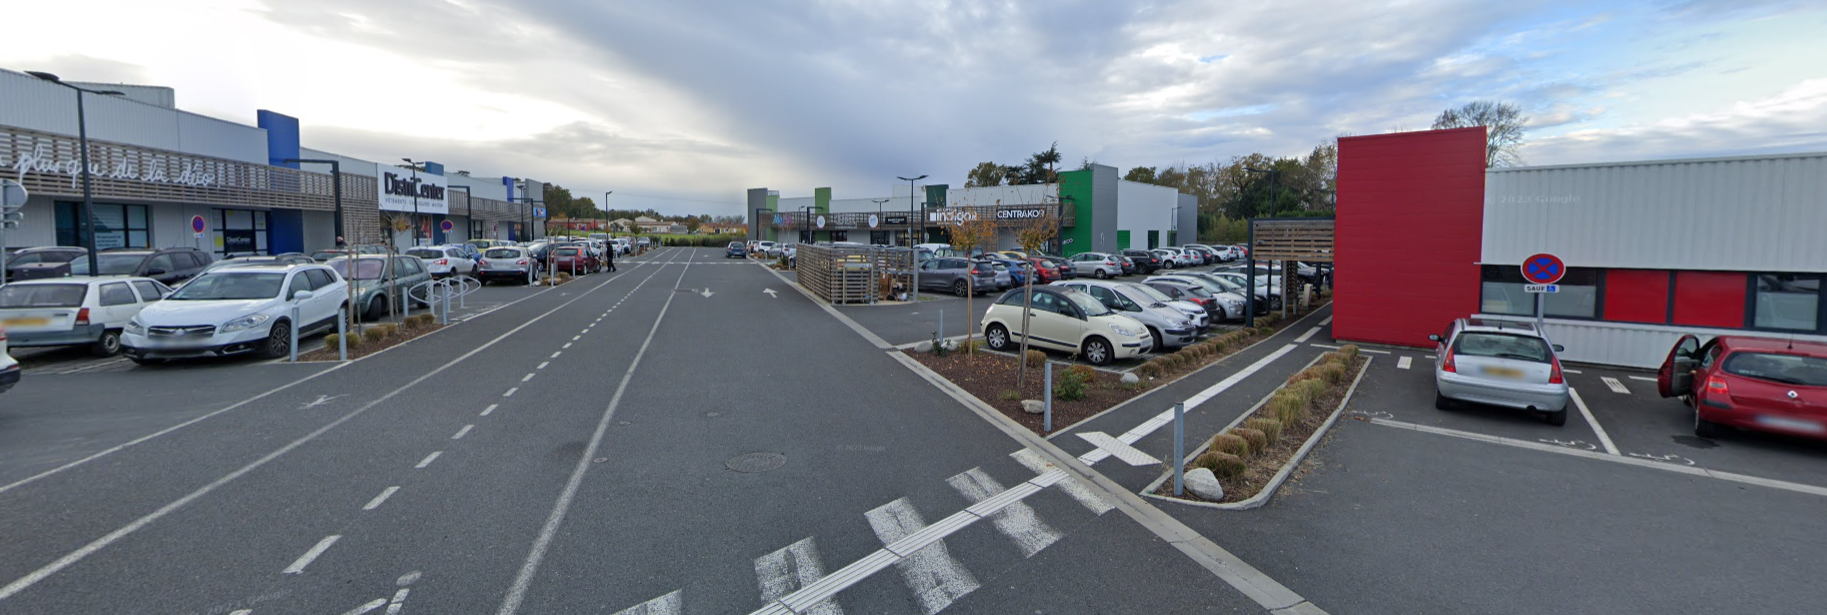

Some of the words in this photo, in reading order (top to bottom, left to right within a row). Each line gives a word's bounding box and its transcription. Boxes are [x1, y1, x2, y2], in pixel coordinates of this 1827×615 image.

[110, 156, 139, 178] de
[140, 158, 170, 182] la
[384, 171, 445, 201] DistriCenter
